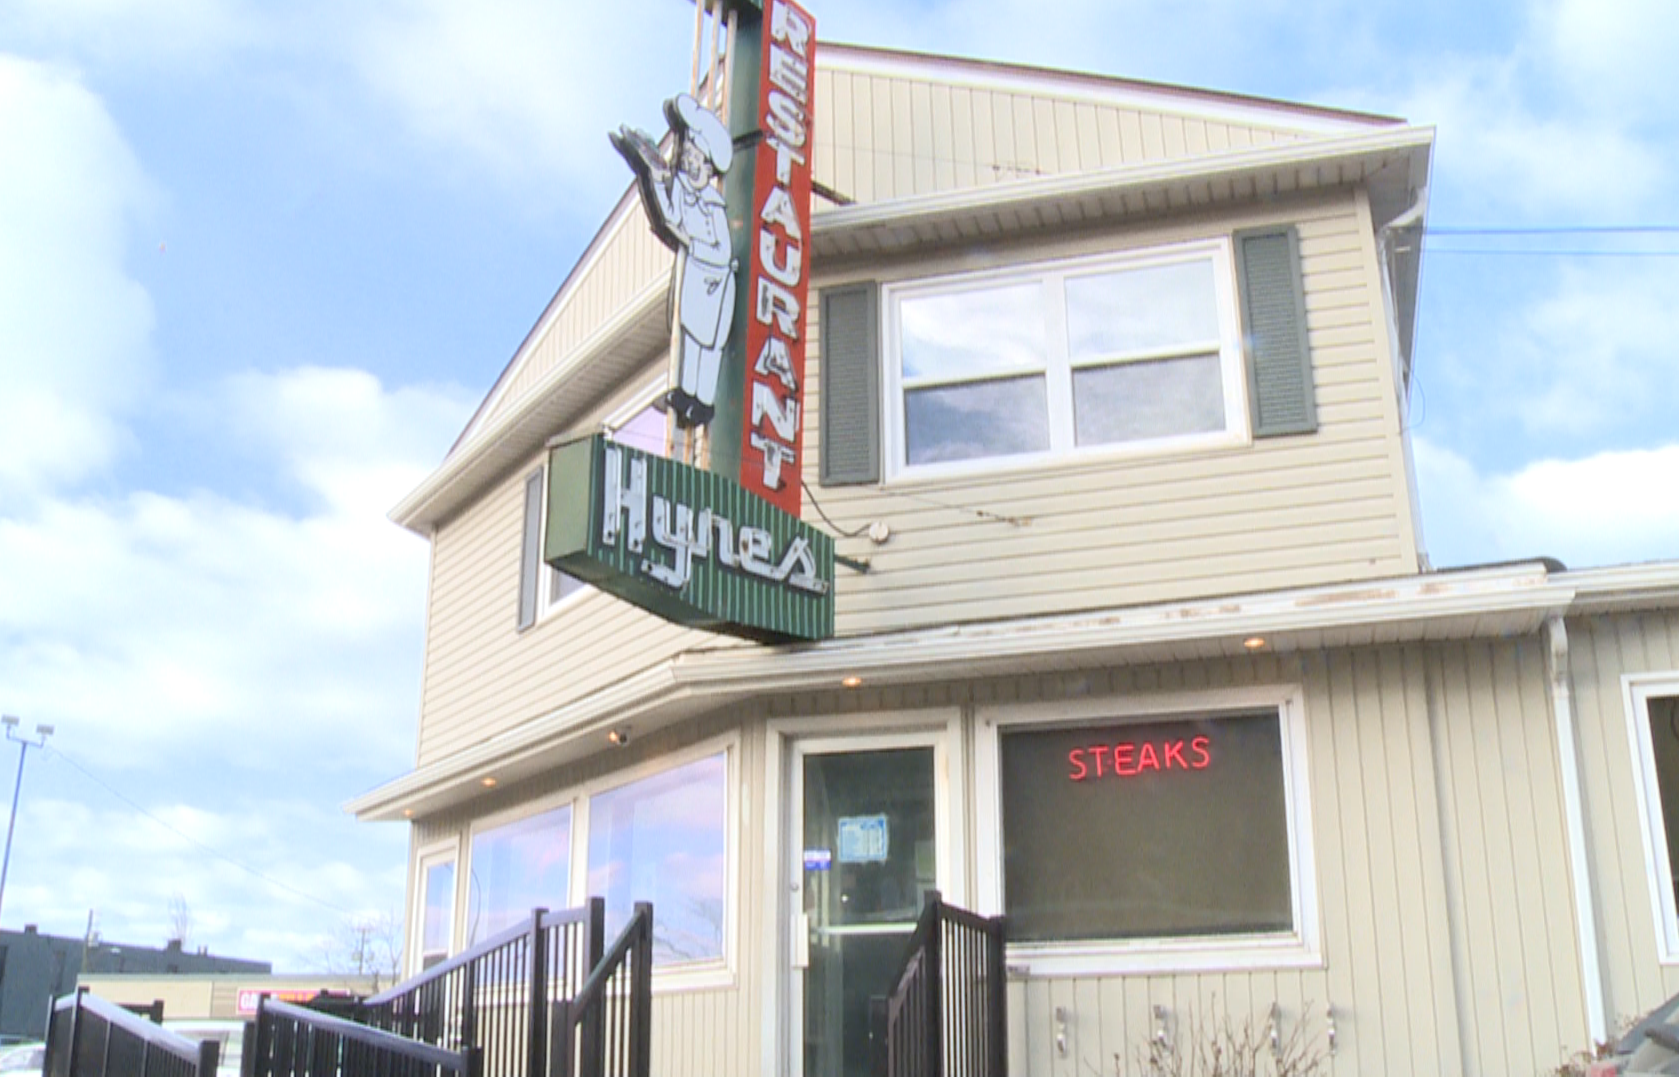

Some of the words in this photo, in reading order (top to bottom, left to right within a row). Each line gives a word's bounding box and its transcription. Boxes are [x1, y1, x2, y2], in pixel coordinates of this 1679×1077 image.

[751, 0, 811, 490] RESTAURANT
[603, 447, 829, 594] Hynes
[1068, 736, 1211, 780] STEAKS
